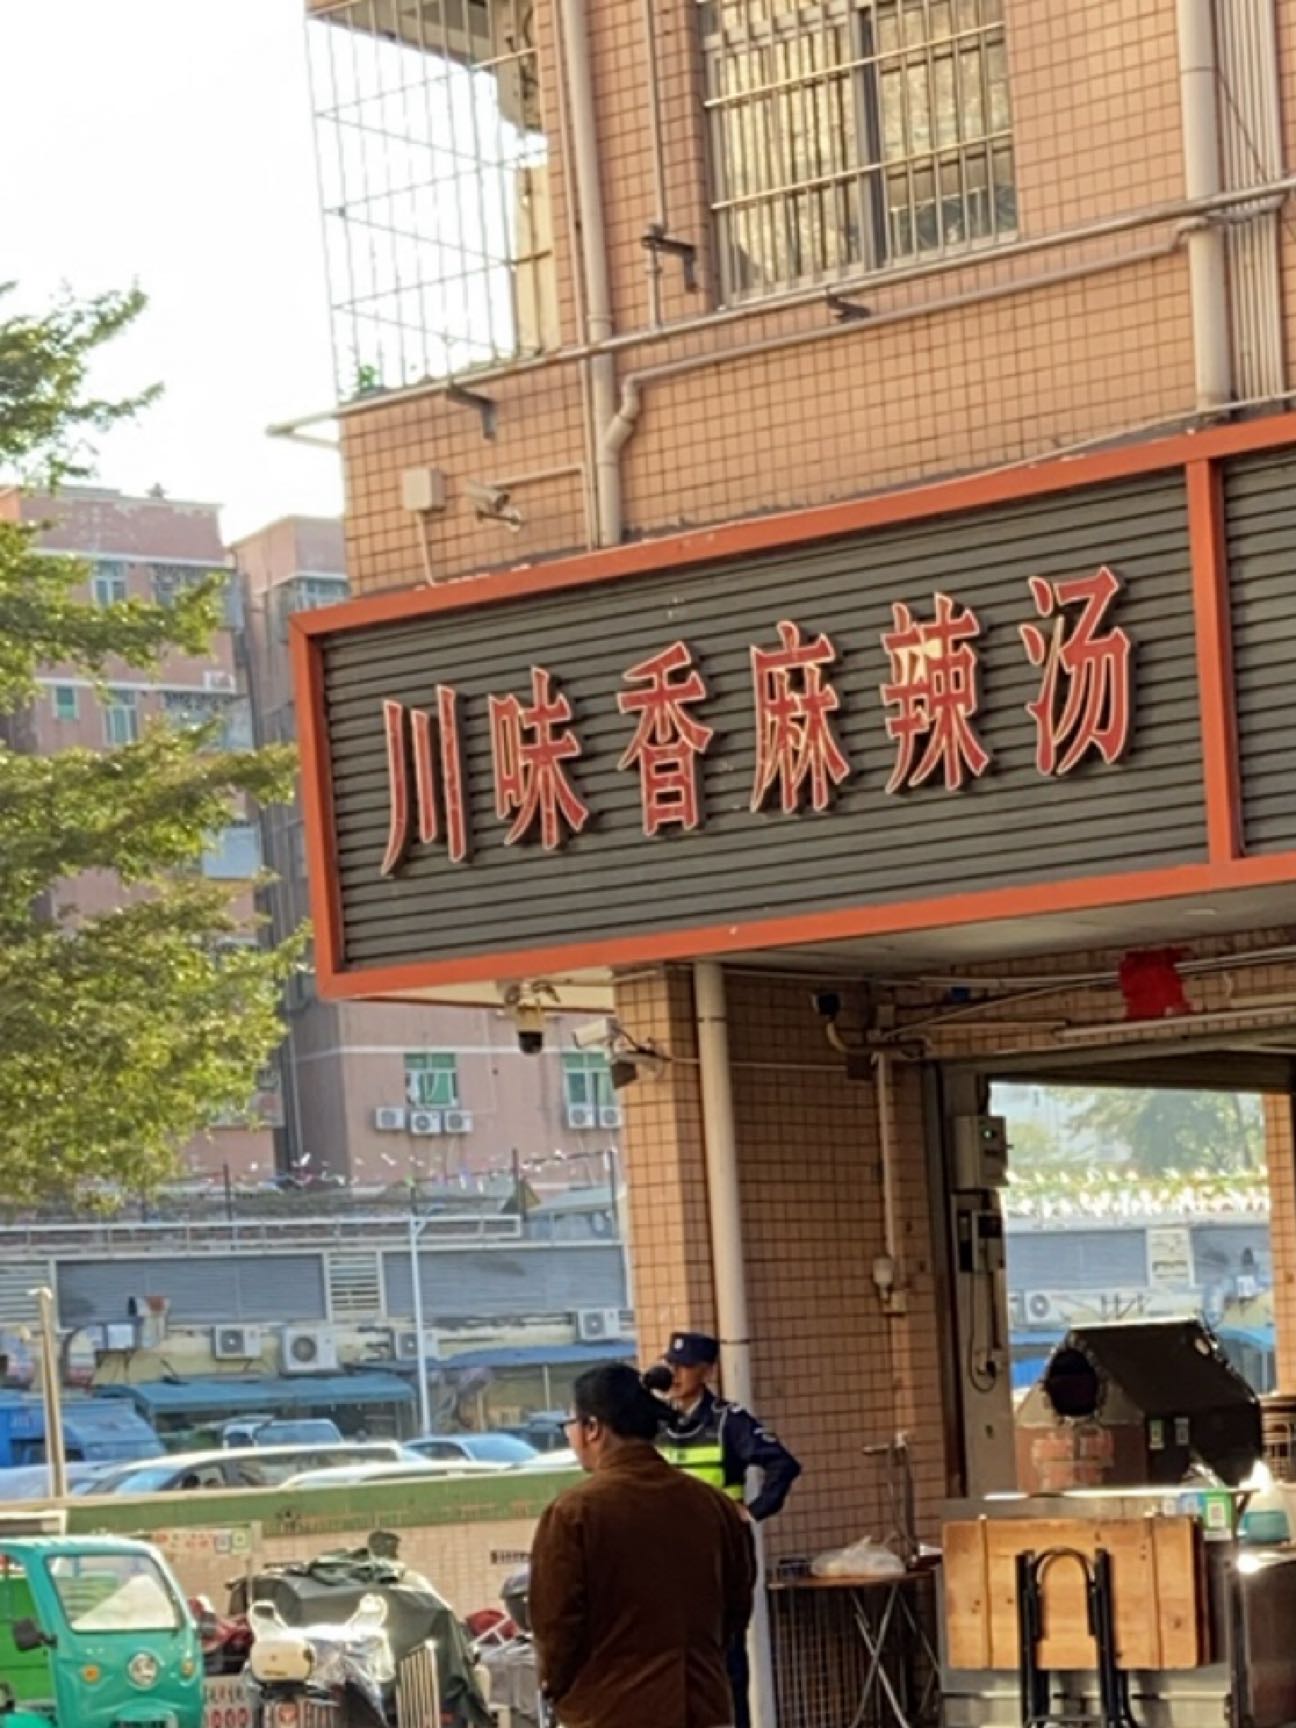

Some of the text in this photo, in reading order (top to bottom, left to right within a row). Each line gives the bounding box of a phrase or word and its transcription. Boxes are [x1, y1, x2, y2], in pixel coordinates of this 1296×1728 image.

[380, 565, 1131, 876] 川味香麻辣汤
